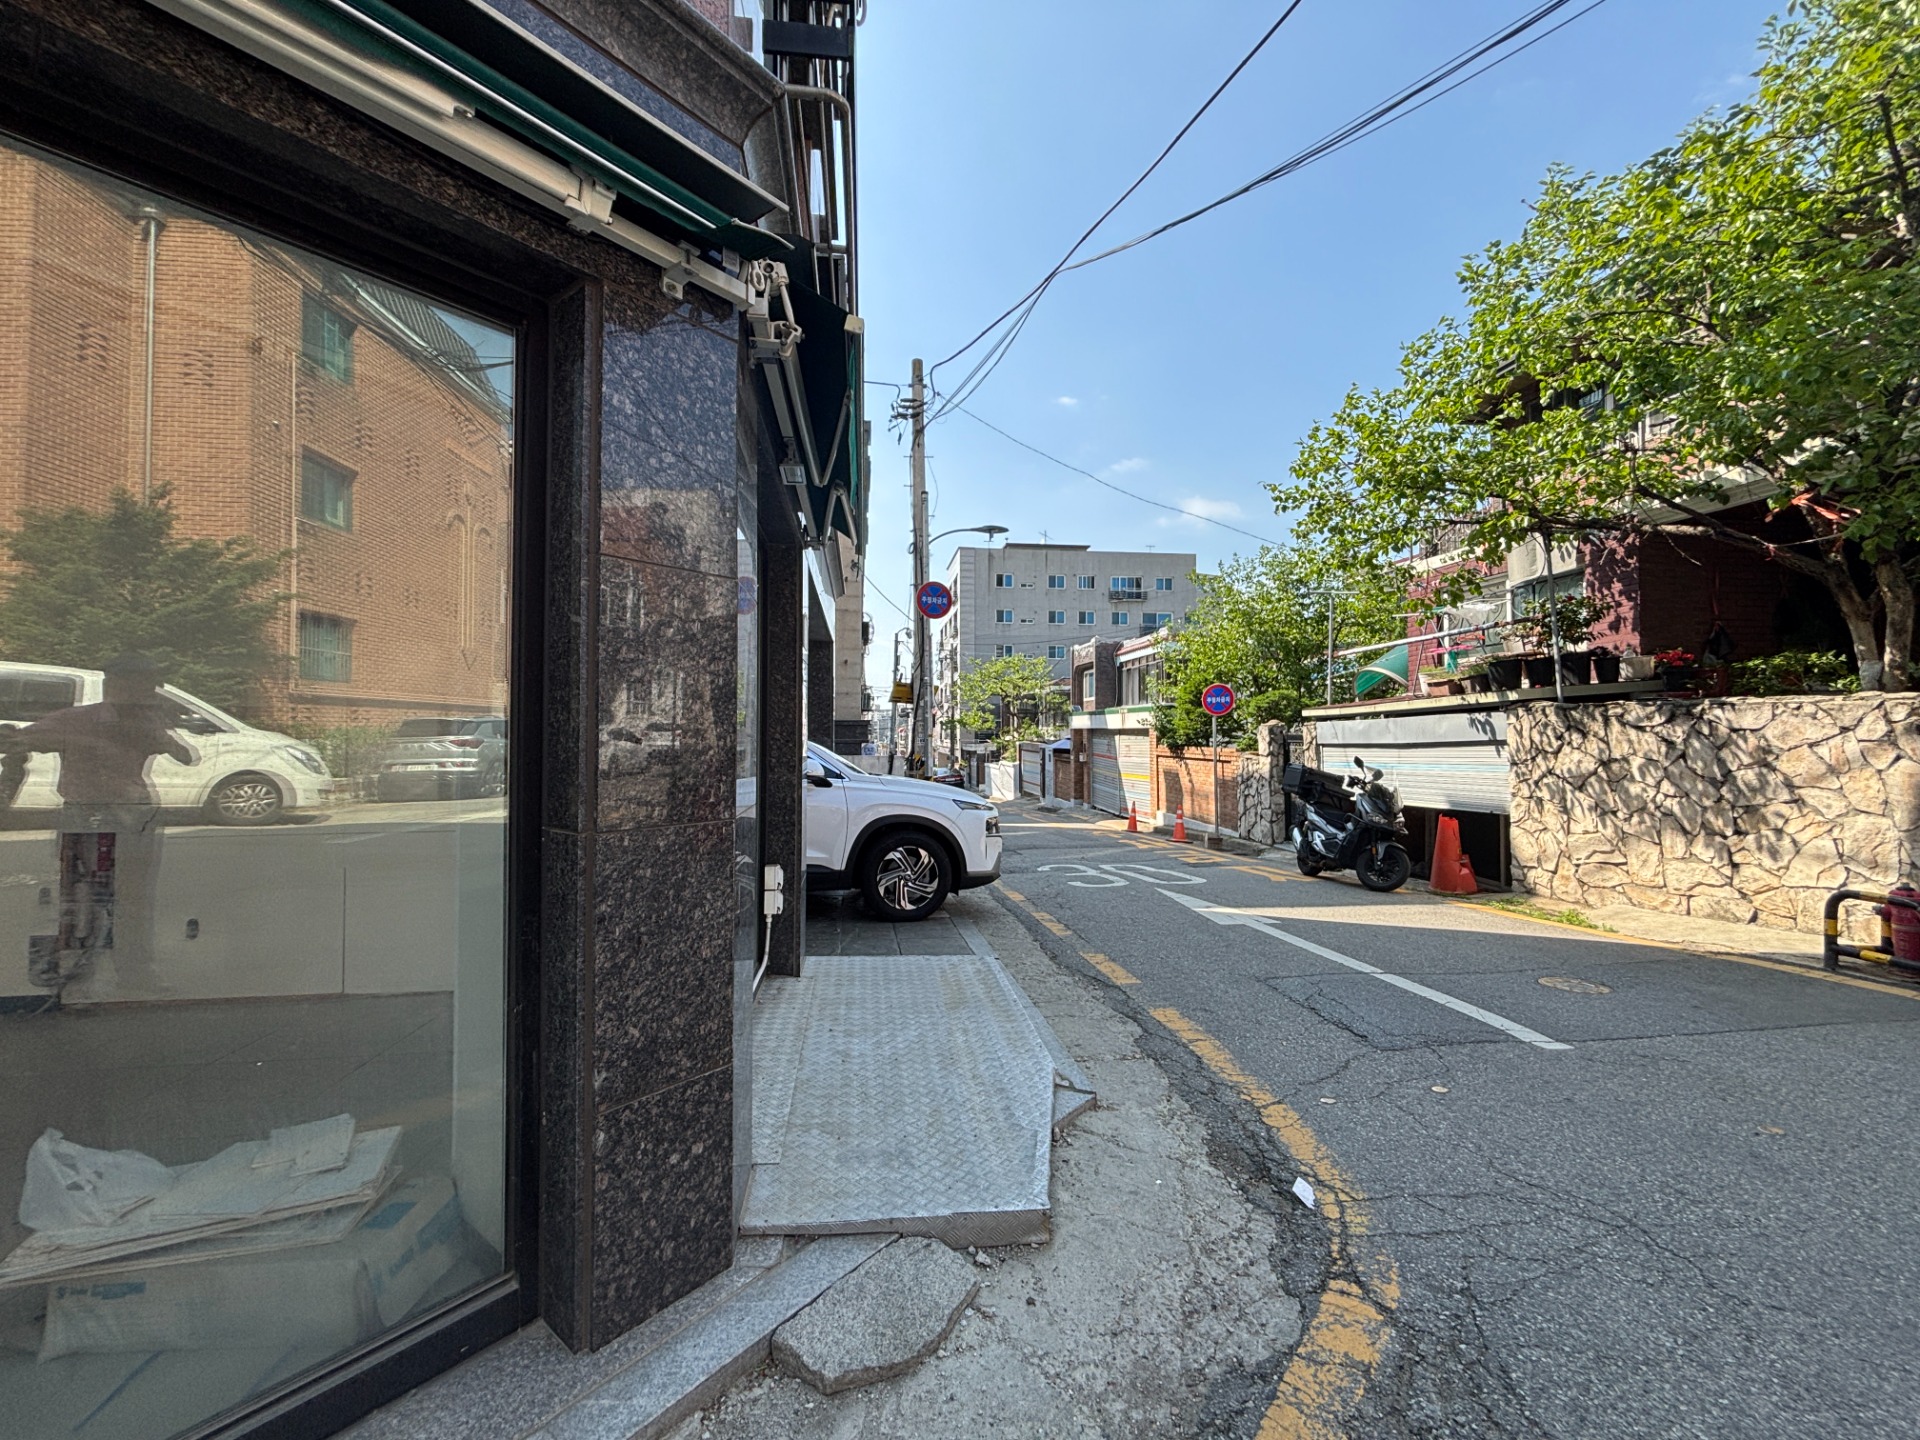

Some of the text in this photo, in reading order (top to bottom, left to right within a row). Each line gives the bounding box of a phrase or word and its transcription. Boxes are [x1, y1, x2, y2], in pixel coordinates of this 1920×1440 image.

[921, 596, 948, 605] 주정차금지
[1207, 695, 1230, 704] 주정차금지
[1037, 863, 1208, 888] 30
